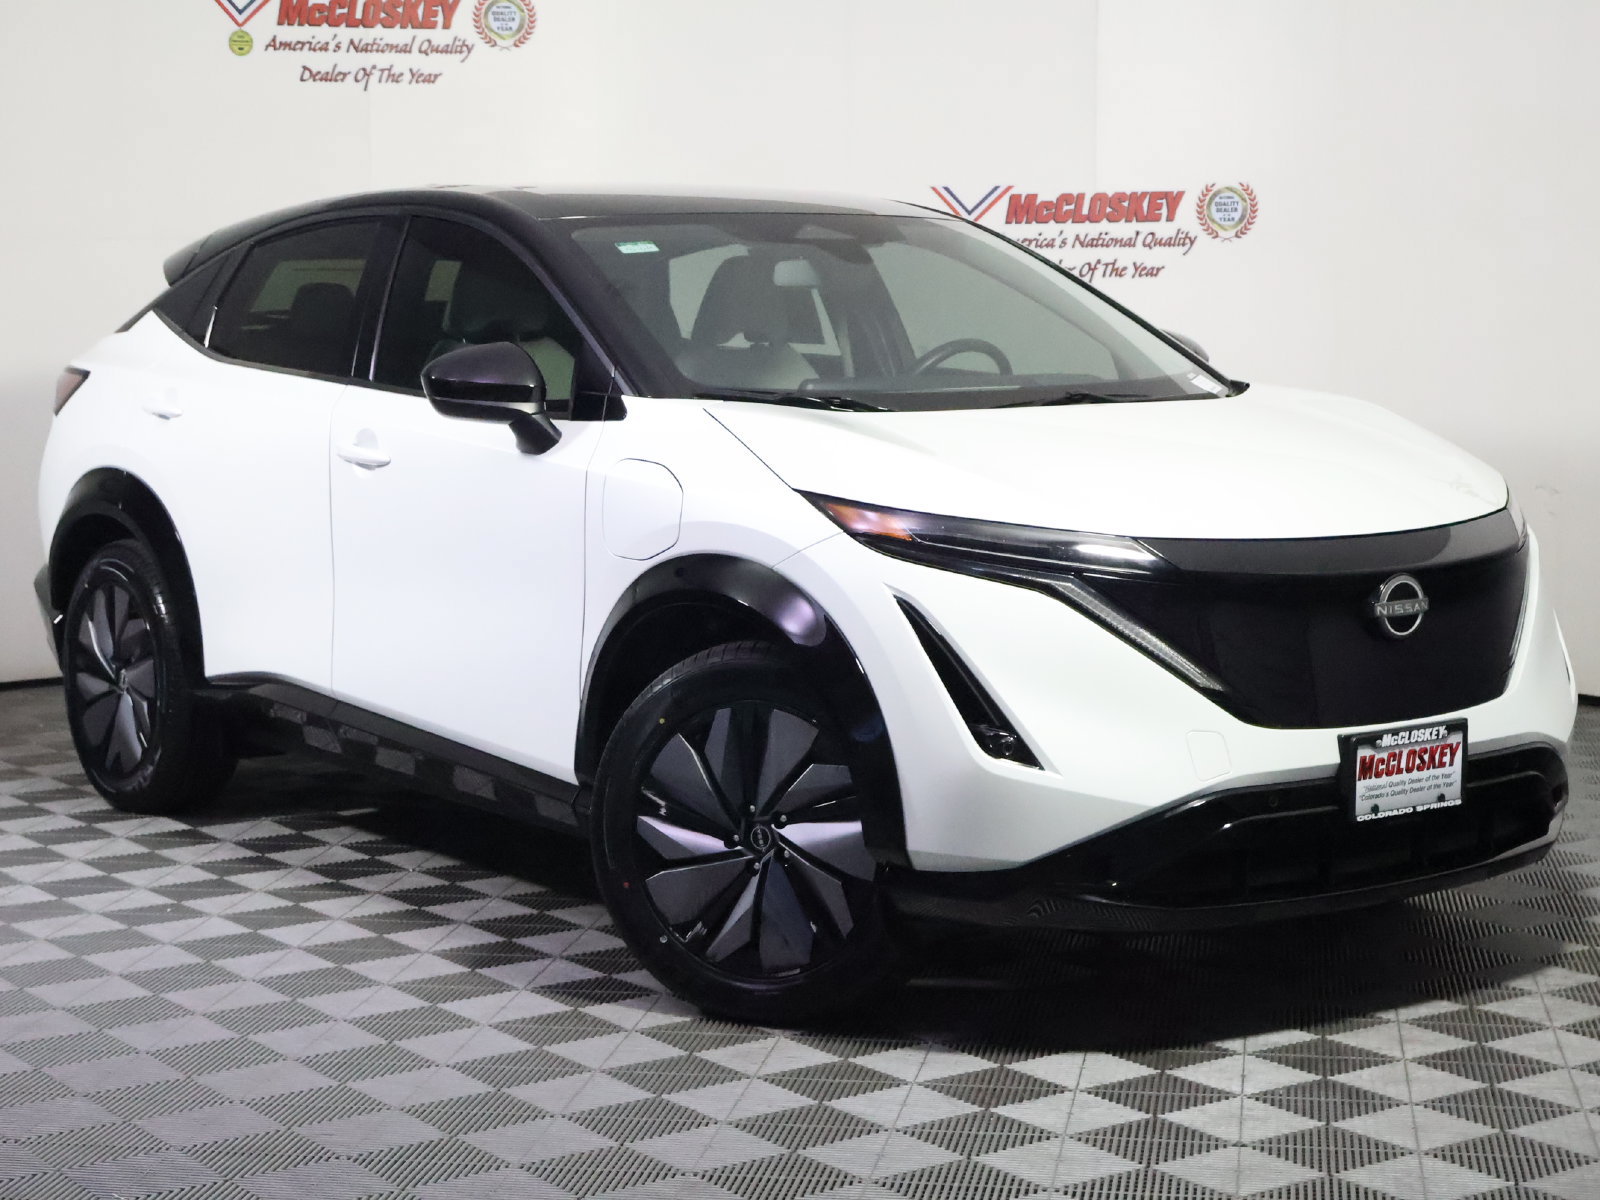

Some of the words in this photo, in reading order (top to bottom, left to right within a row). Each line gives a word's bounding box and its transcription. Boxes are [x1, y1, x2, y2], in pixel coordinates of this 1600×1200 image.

[277, 0, 460, 29] McCLOSKEY
[264, 33, 342, 53] America's
[346, 35, 416, 54] National
[418, 36, 474, 63] Quality
[299, 64, 351, 83] Dealer
[354, 65, 377, 91] Of
[377, 64, 404, 84] The
[408, 68, 443, 85] Year
[1005, 191, 1185, 224] McCLOSKEY
[1072, 230, 1140, 249] National
[1142, 229, 1197, 255] Quality
[1079, 259, 1101, 283] Of
[1102, 259, 1127, 278] The
[1131, 262, 1165, 279] Year
[1376, 601, 1428, 615] NISSAN
[1381, 725, 1447, 747] McCLOSKEY
[1357, 742, 1461, 781] McCLOSKEY
[1388, 779, 1406, 788] Quality
[1408, 777, 1424, 785] Dealer
[1390, 788, 1408, 797] Quality
[1409, 785, 1426, 793] Dealer
[1357, 807, 1413, 822] COLORADO
[1415, 799, 1462, 812] SPRINGS
